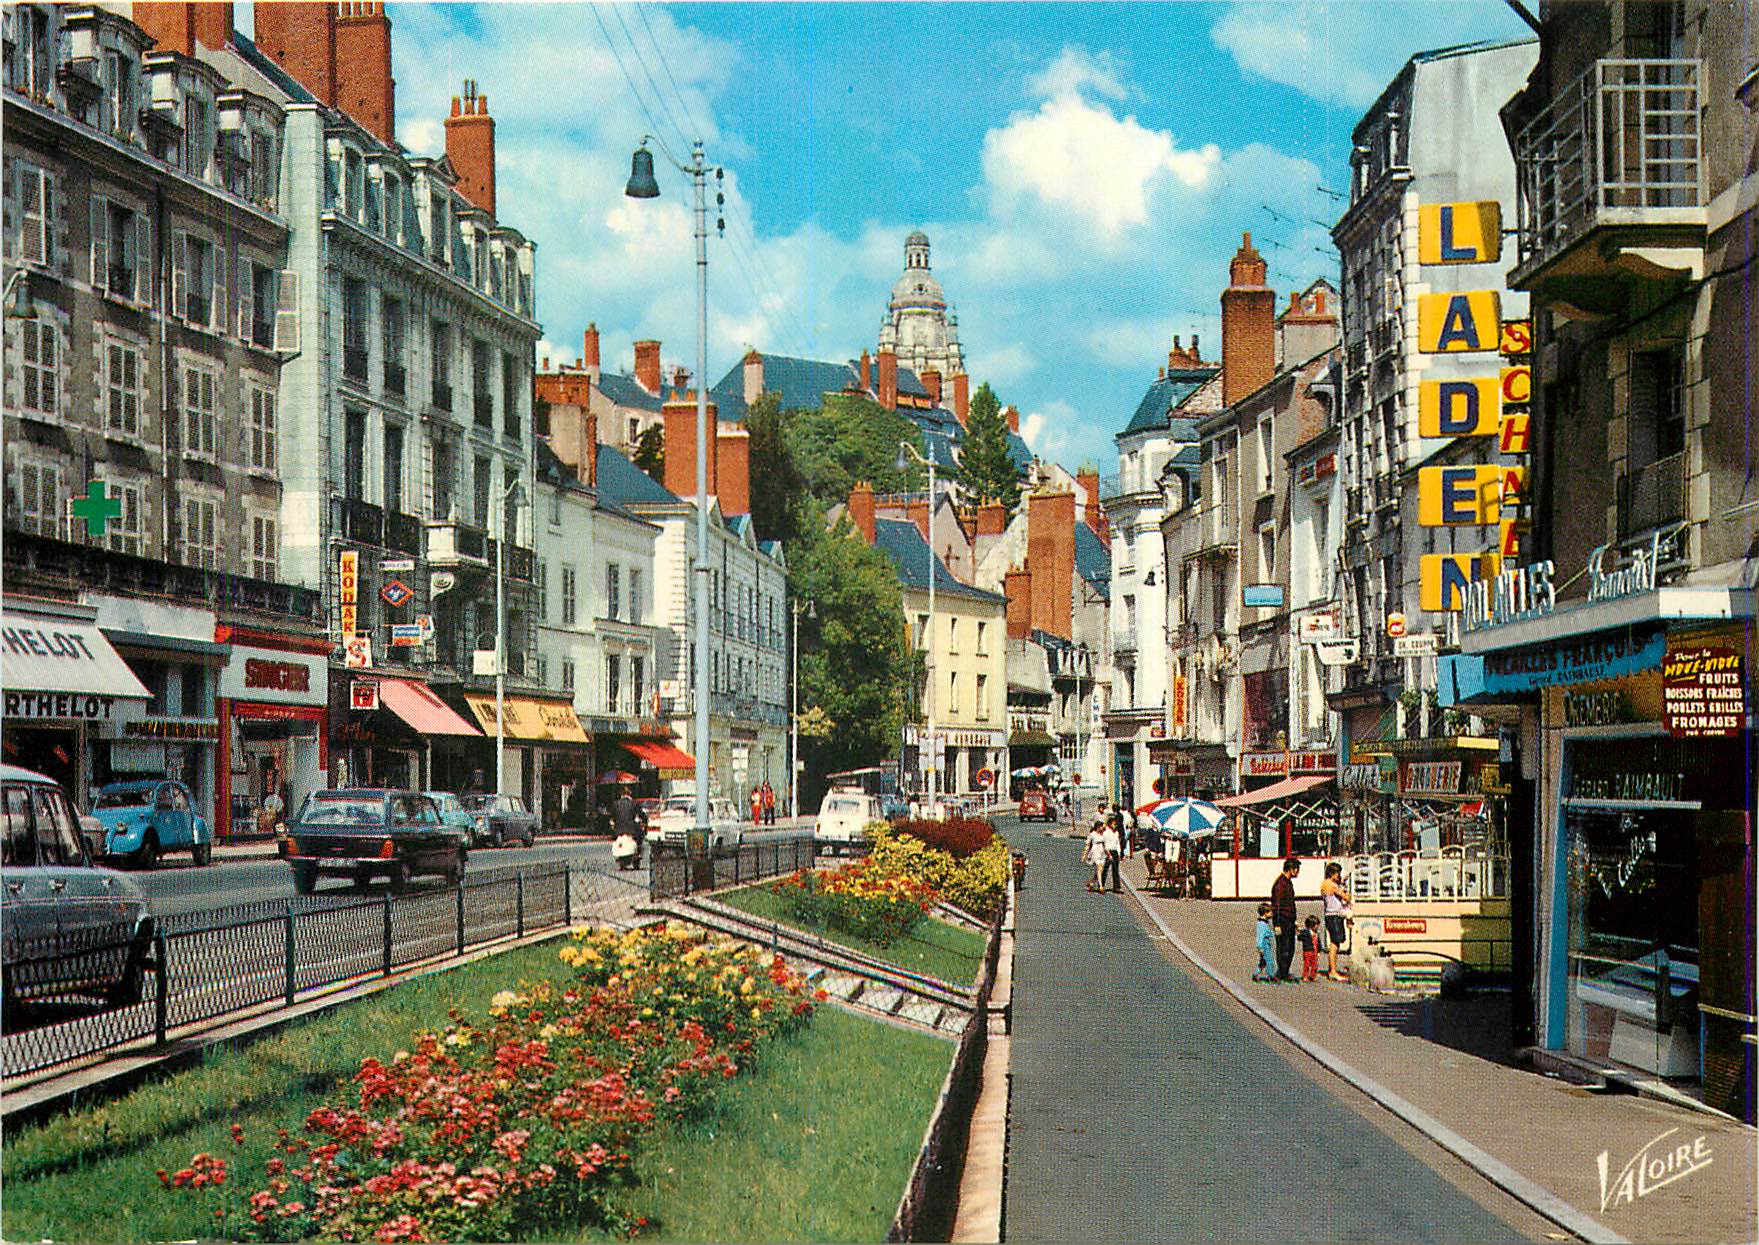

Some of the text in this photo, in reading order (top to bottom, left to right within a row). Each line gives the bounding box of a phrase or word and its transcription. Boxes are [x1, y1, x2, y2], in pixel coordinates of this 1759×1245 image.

[1437, 206, 1482, 609] LADEN
[342, 560, 355, 632] KODAK
[1699, 672, 1739, 684] FRUITS
[1666, 702, 1706, 714] POULETS
[1672, 716, 1738, 728] FROMAGES
